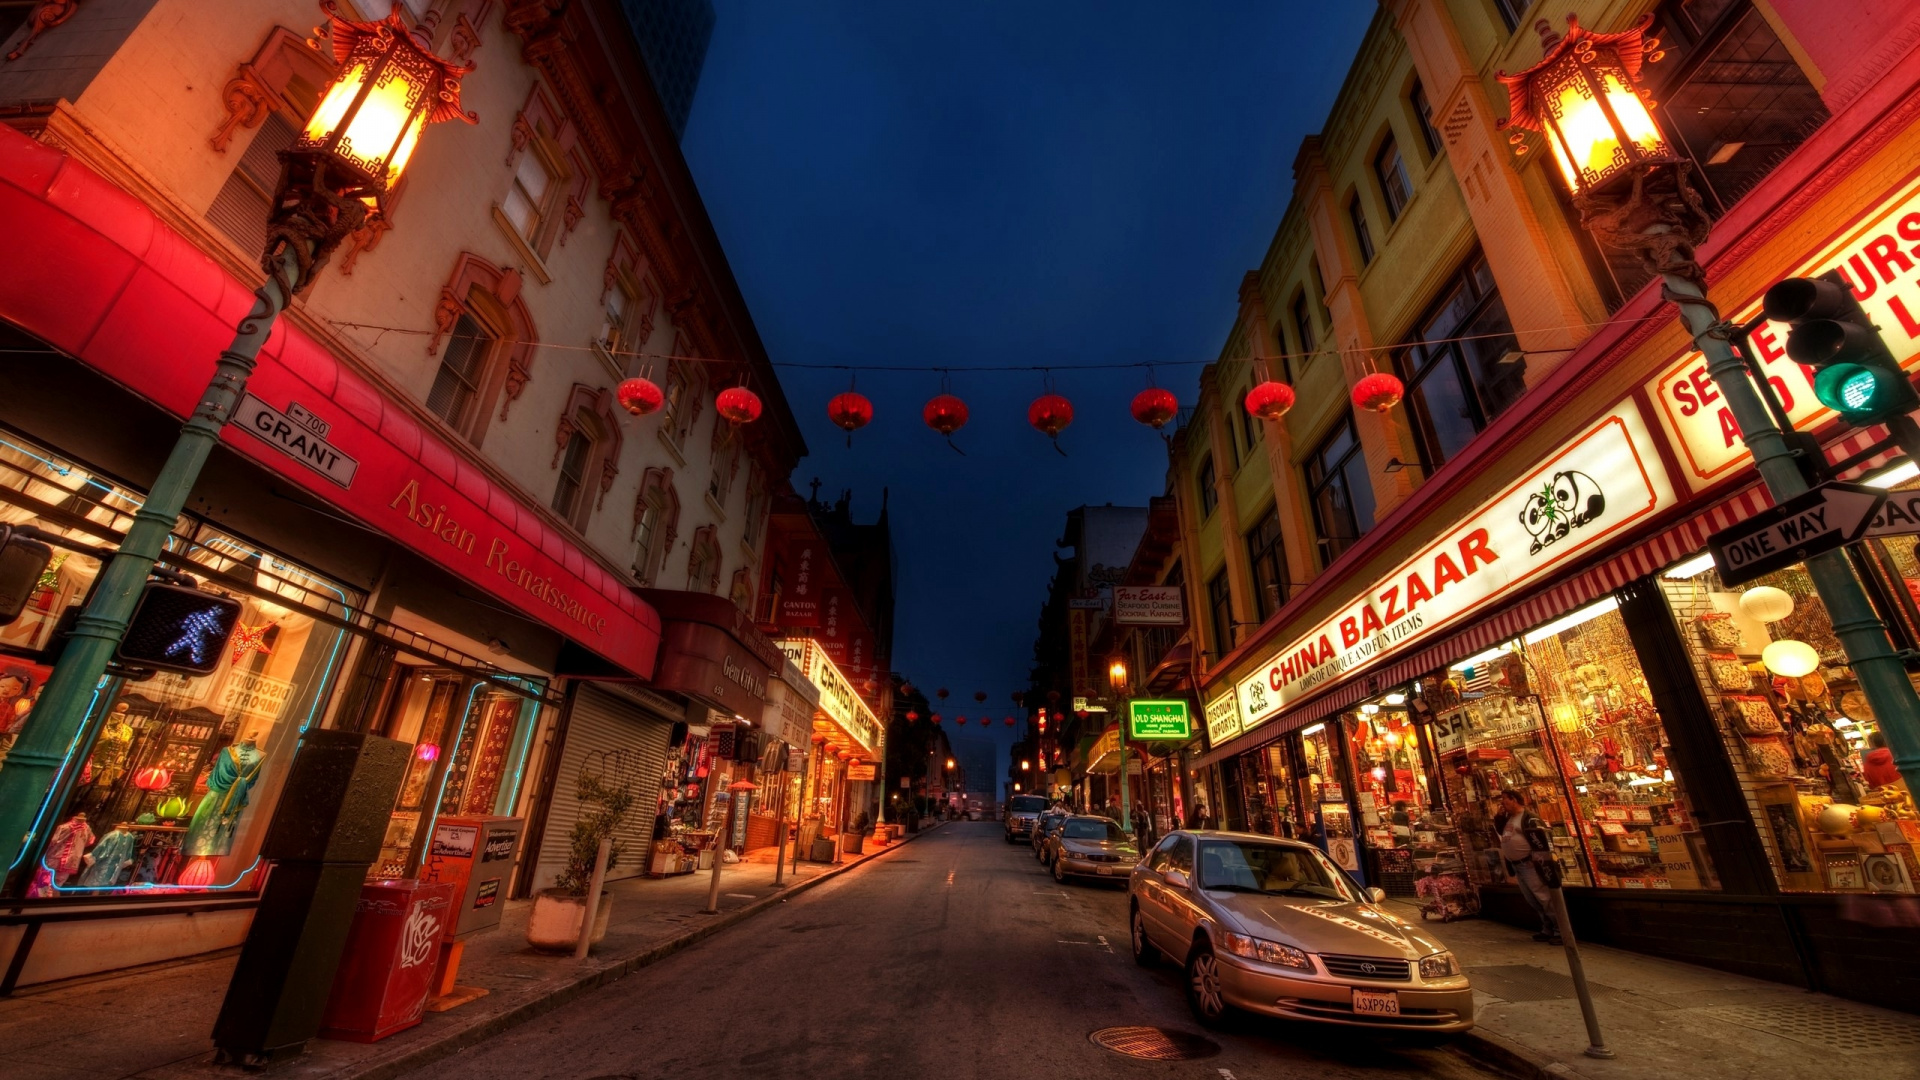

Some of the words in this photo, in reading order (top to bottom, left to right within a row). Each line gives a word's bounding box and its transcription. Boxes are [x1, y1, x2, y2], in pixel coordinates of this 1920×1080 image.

[1672, 321, 1786, 417] SEE
[1717, 376, 1796, 449] AD
[305, 413, 327, 435] 700
[255, 410, 341, 471] GRANT
[1728, 531, 1776, 566] ONE
[1777, 507, 1830, 546] WAY
[389, 479, 477, 556] Asian
[485, 536, 607, 637] Renaissance
[1116, 588, 1137, 601] Far
[1139, 588, 1167, 602] East
[783, 600, 817, 610] CANTON
[786, 610, 813, 618] BAZAAR
[1117, 601, 1150, 609] SEAFOOD
[1152, 601, 1181, 610] CUISINE
[1117, 609, 1149, 617] COCKTAIL
[1150, 610, 1182, 618] KARAOKE
[1268, 633, 1336, 692] CHINA
[1339, 527, 1500, 649] BAZAAR
[821, 642, 844, 650] ANTON
[1316, 667, 1329, 684] OF
[1326, 651, 1355, 677] UNIQUE
[1355, 641, 1372, 662] AND
[1371, 630, 1392, 653] FUN
[1391, 612, 1424, 642] ITEMS
[722, 655, 740, 681] Gem
[740, 666, 755, 699] City
[714, 685, 724, 697] 658
[820, 663, 854, 714] CANTON
[1135, 714, 1149, 723] OLD
[1150, 714, 1185, 723] SHANGHAI
[1207, 695, 1236, 724] DISCOUNT
[1211, 714, 1236, 740] IMPORTS
[485, 839, 514, 854] Advertiser
[1655, 834, 1683, 845] FRONT
[1664, 862, 1692, 871] FRONT
[1356, 997, 1397, 1013] 4SXP963
